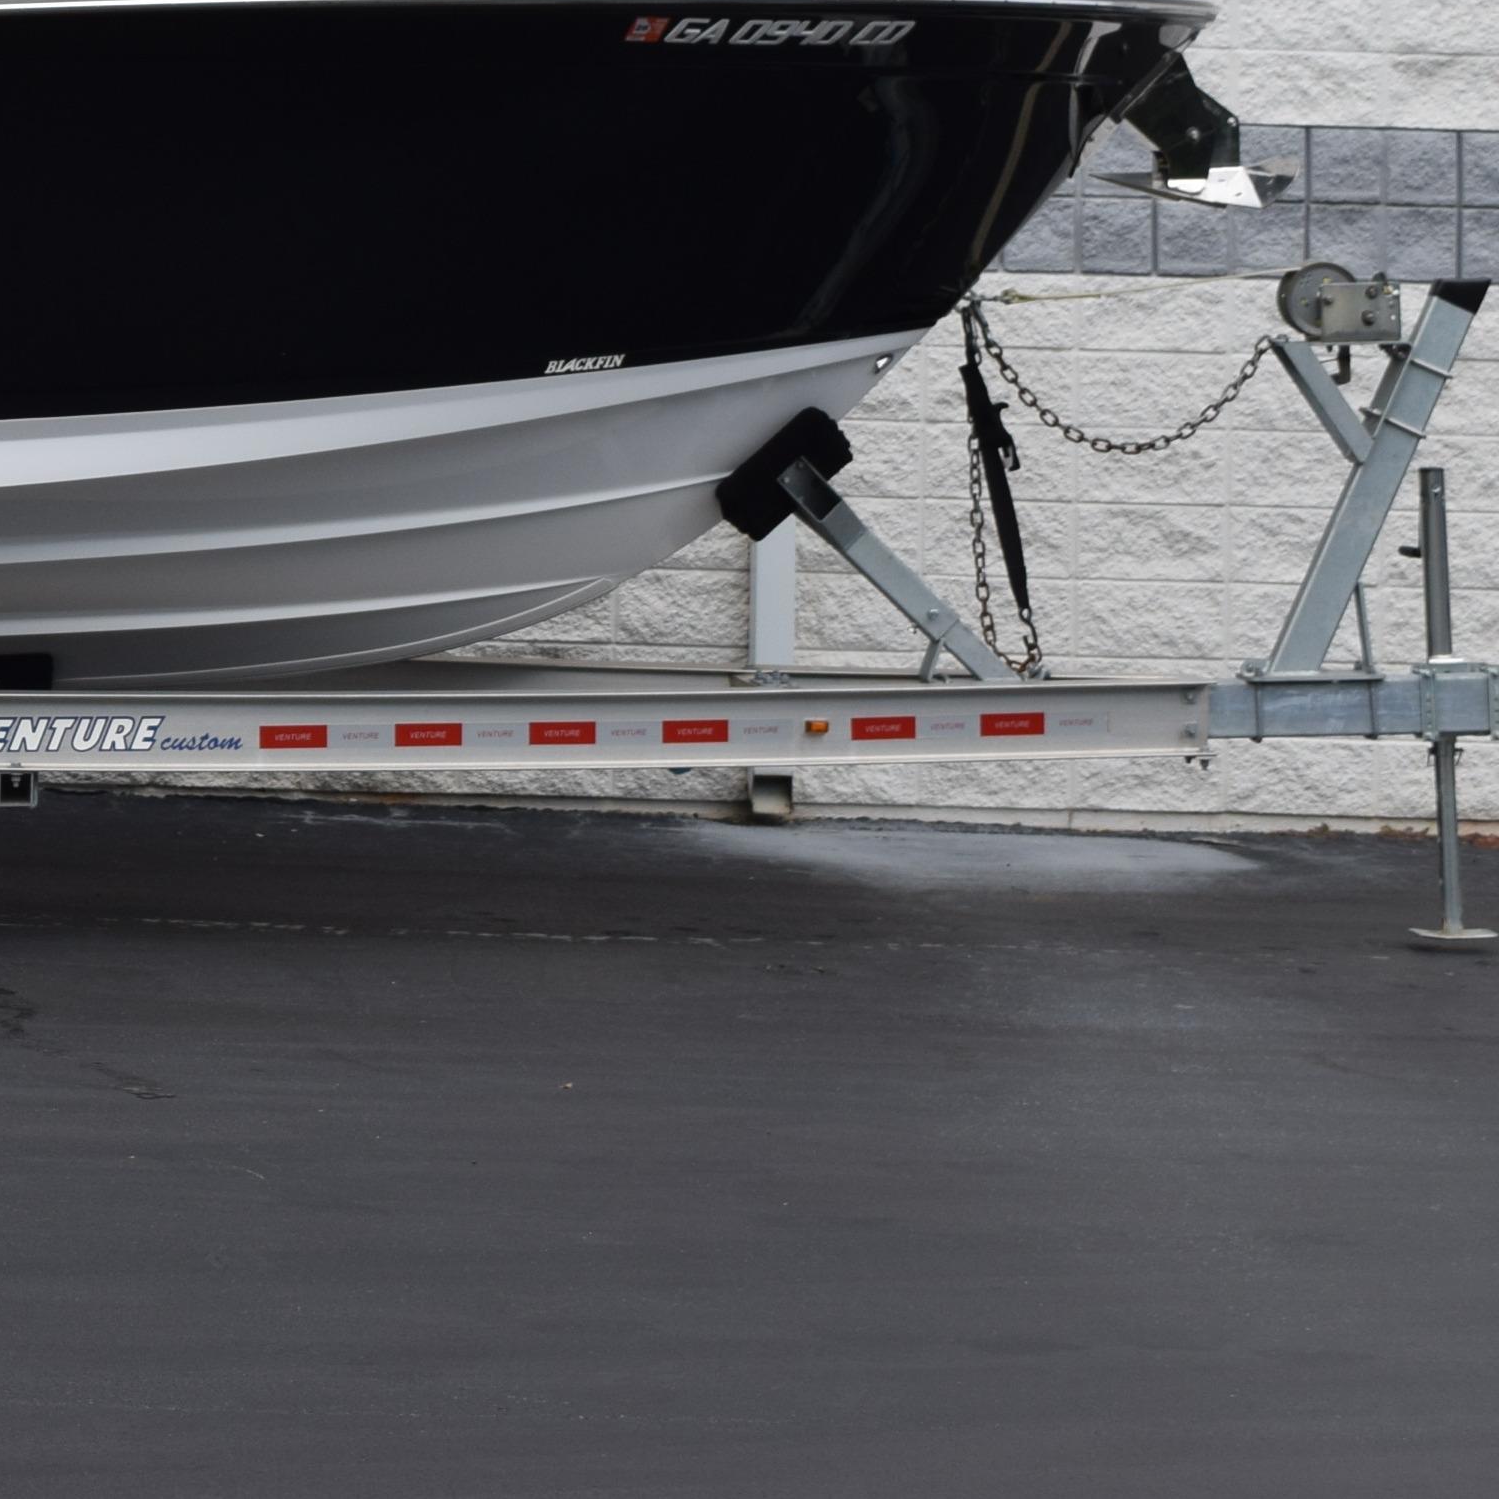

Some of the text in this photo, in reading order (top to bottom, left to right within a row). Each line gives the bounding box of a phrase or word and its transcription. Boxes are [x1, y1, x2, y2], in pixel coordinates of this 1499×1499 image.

[664, 18, 731, 44] GA
[544, 354, 626, 374] BLACKFIN
[160, 732, 243, 751] custom
[274, 732, 312, 741] VENTURE
[409, 730, 447, 739] VENTURE
[544, 729, 580, 737] VENTURE
